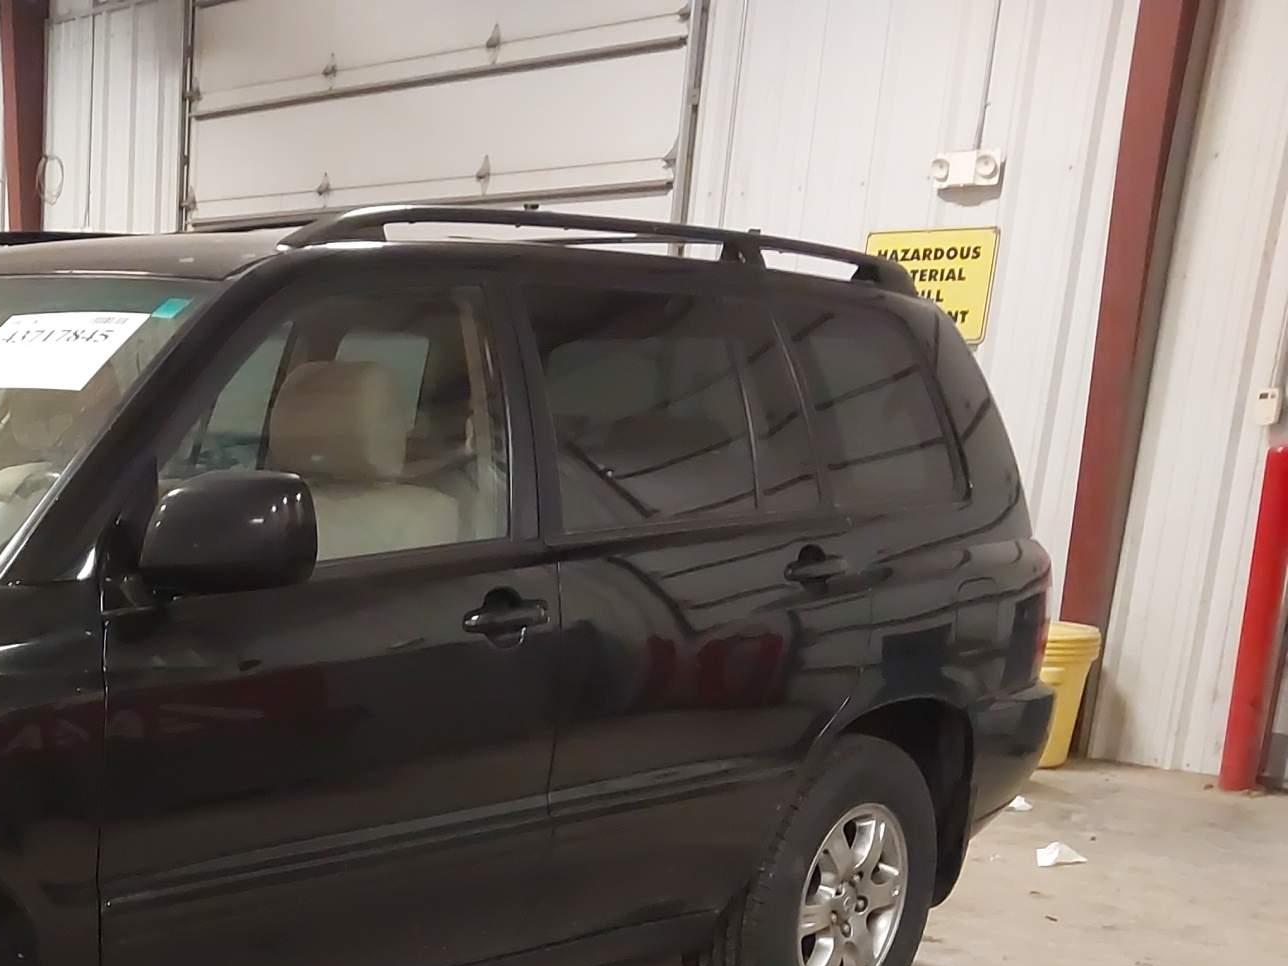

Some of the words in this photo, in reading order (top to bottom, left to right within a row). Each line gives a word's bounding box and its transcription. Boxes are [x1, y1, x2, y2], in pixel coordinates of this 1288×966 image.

[877, 246, 981, 261] HAZARDOUS
[910, 268, 966, 281] TERIAL
[2, 329, 115, 343] 43717845
